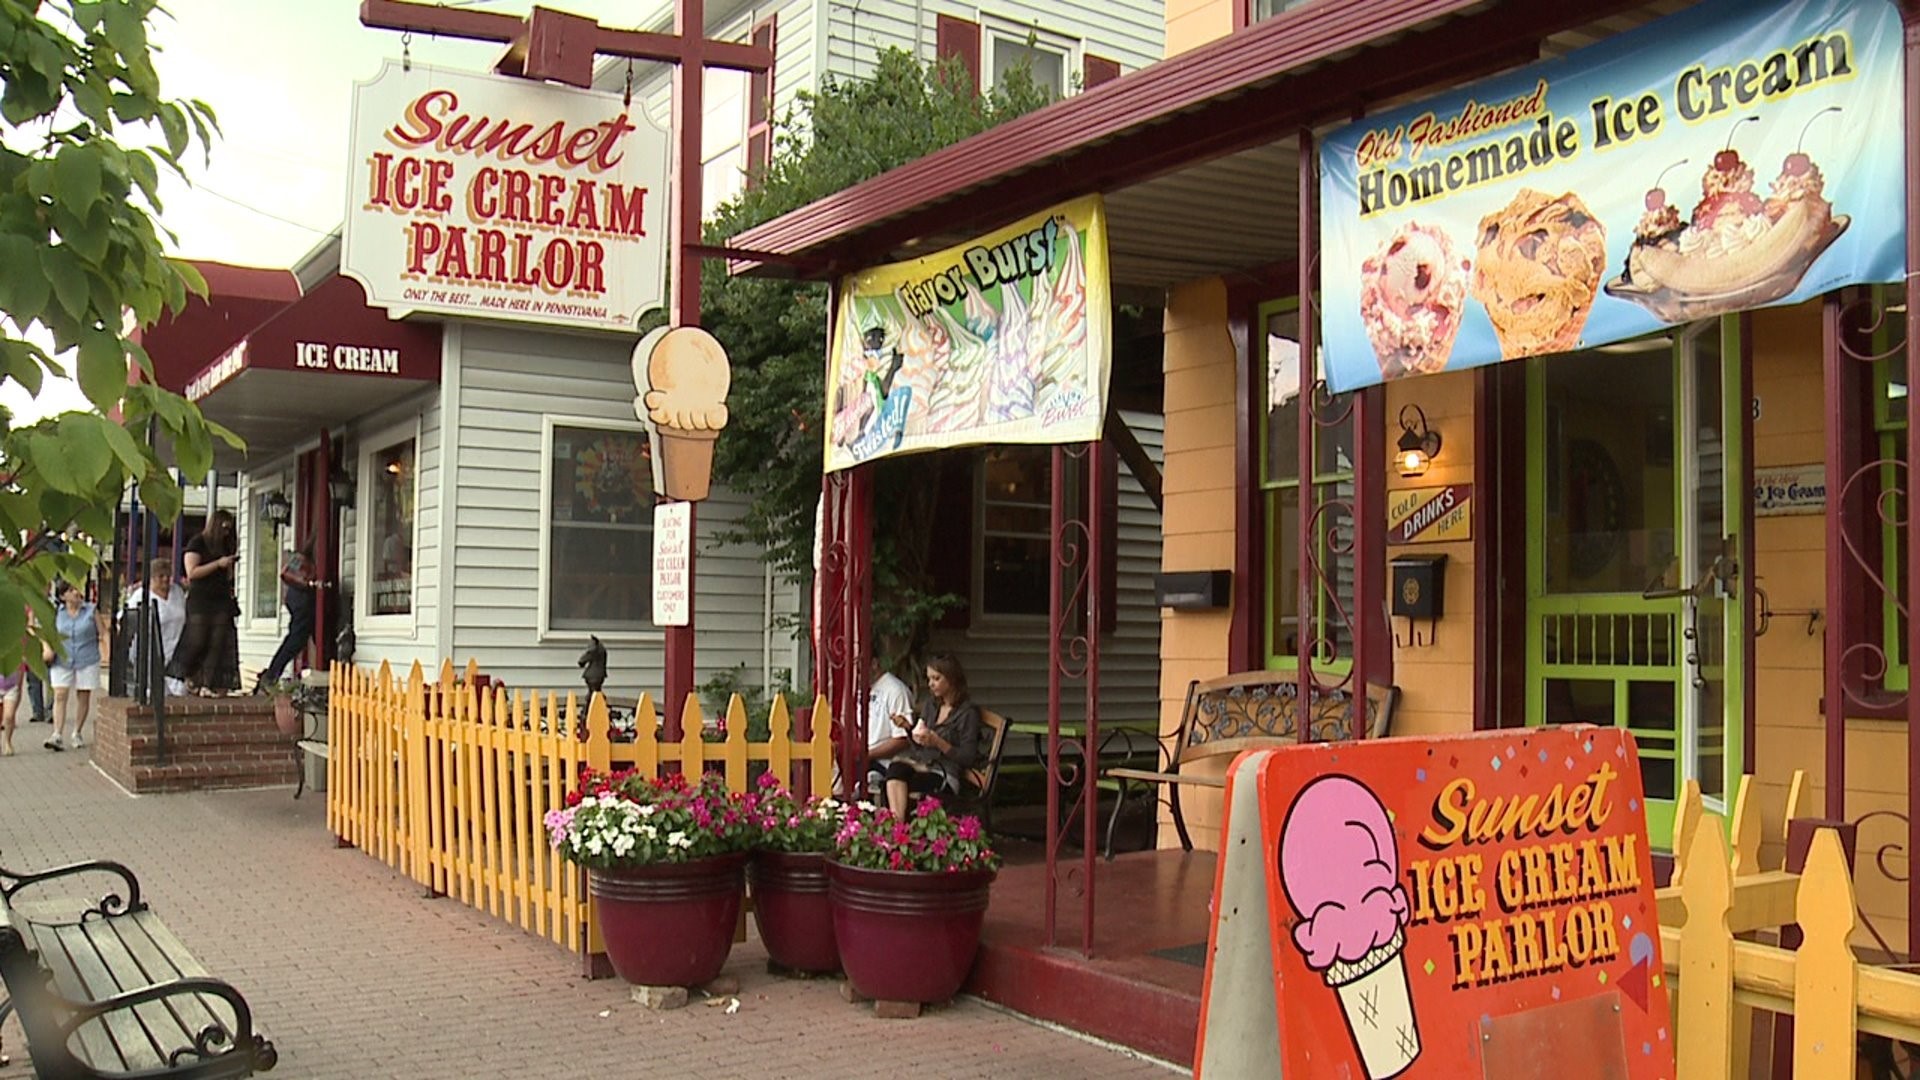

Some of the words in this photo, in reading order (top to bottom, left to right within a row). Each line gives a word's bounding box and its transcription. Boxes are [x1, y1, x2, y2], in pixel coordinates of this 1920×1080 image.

[389, 90, 636, 171] Sunset
[1356, 128, 1401, 167] Old
[1409, 80, 1547, 160] Fashioned
[1357, 116, 1579, 216] Homemade
[1592, 94, 1661, 150] Ice
[1677, 32, 1852, 120] Cream
[367, 152, 454, 216] ICE
[468, 166, 648, 239] CREAM
[404, 221, 606, 295] PARLOR
[900, 267, 965, 317] Flavor
[964, 217, 1057, 291] Burst
[403, 287, 428, 300] ONLY
[431, 290, 447, 303] THE
[480, 295, 507, 309] MADE
[508, 298, 531, 311] HERE
[532, 301, 543, 312] IN
[545, 301, 608, 318] PENNSYLVANIA
[296, 342, 329, 368] ICE
[333, 346, 399, 373] CREAM
[1392, 493, 1417, 519] COLD
[1403, 487, 1454, 540] DRINKS
[1438, 505, 1465, 535] HERE
[1418, 762, 1618, 850] Sunset
[1410, 854, 1486, 926] ICE
[1497, 833, 1641, 912] CREAM
[1451, 901, 1620, 991] PARLOR
